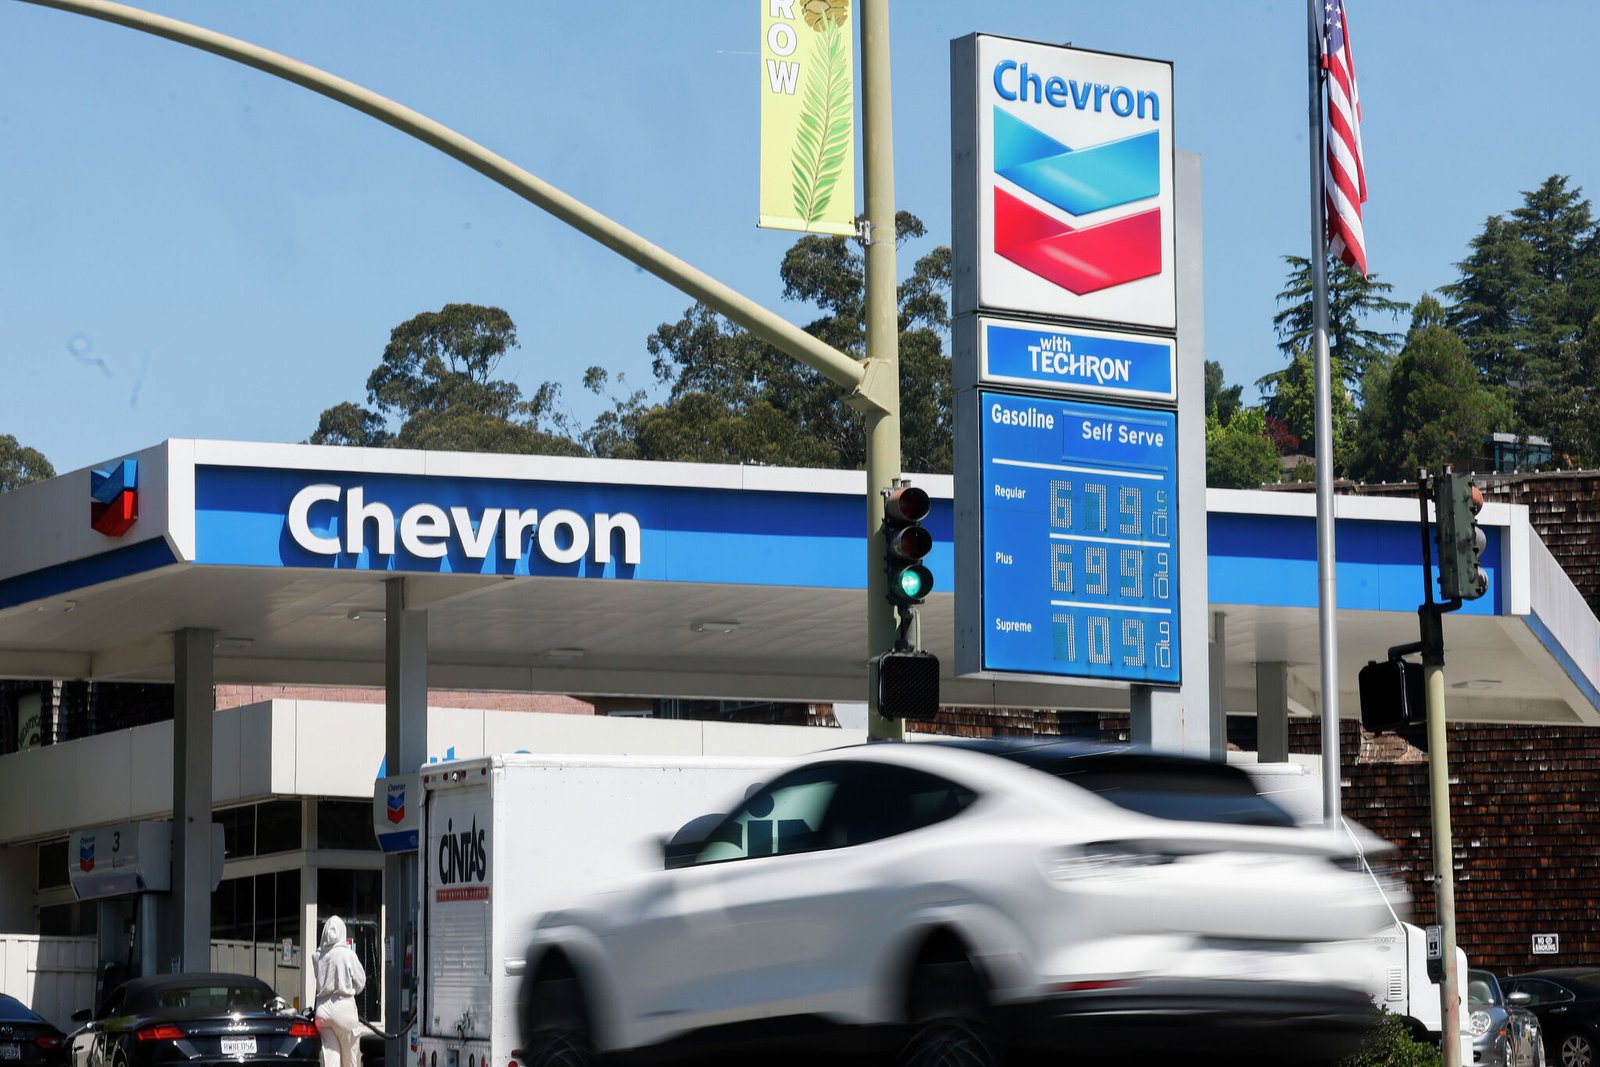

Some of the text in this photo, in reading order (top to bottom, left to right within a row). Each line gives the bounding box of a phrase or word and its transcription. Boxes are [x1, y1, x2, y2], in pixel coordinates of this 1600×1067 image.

[993, 59, 1160, 121] Chevron
[1040, 336, 1071, 353] with
[1028, 346, 1130, 384] TECHRON
[991, 403, 1055, 430] Gasoline
[1082, 421, 1164, 447] Self Serve
[994, 484, 1026, 500] Regular
[287, 483, 641, 565] Chevron
[995, 551, 1013, 566] Plus
[995, 618, 1032, 633] Supreme
[112, 831, 120, 852] 3
[438, 812, 487, 885] CINTAS
